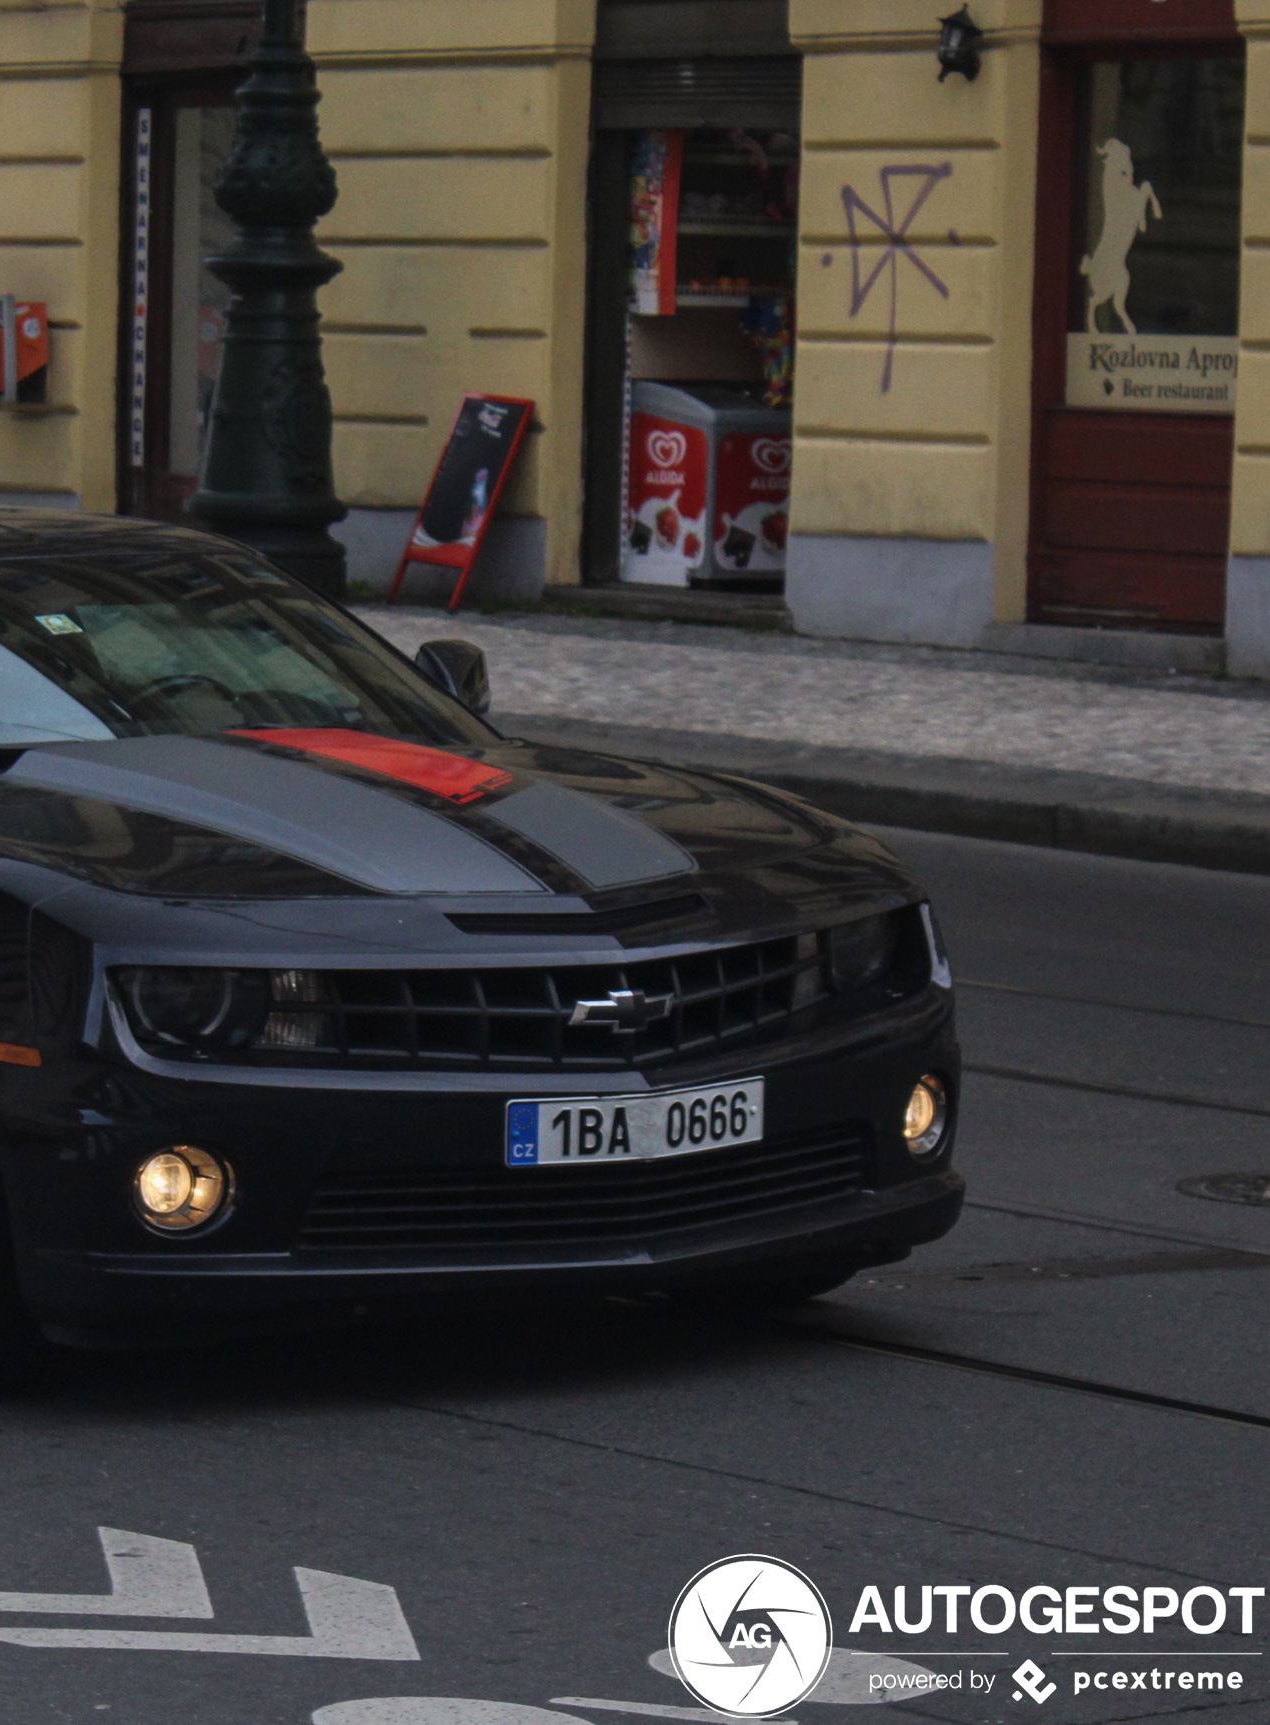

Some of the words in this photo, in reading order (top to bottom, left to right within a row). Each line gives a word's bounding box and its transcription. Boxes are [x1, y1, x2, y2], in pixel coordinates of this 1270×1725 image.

[137, 119, 149, 295] SMENARNA
[1090, 344, 1180, 373] Kozlovna
[133, 326, 145, 456] CHANGE
[1123, 378, 1153, 398] Beer
[1157, 382, 1229, 400] restaurant
[646, 470, 685, 484] ALGIDA
[552, 1106, 630, 1156] 1BA
[666, 1090, 748, 1148] 0666
[513, 1144, 534, 1158] CZ
